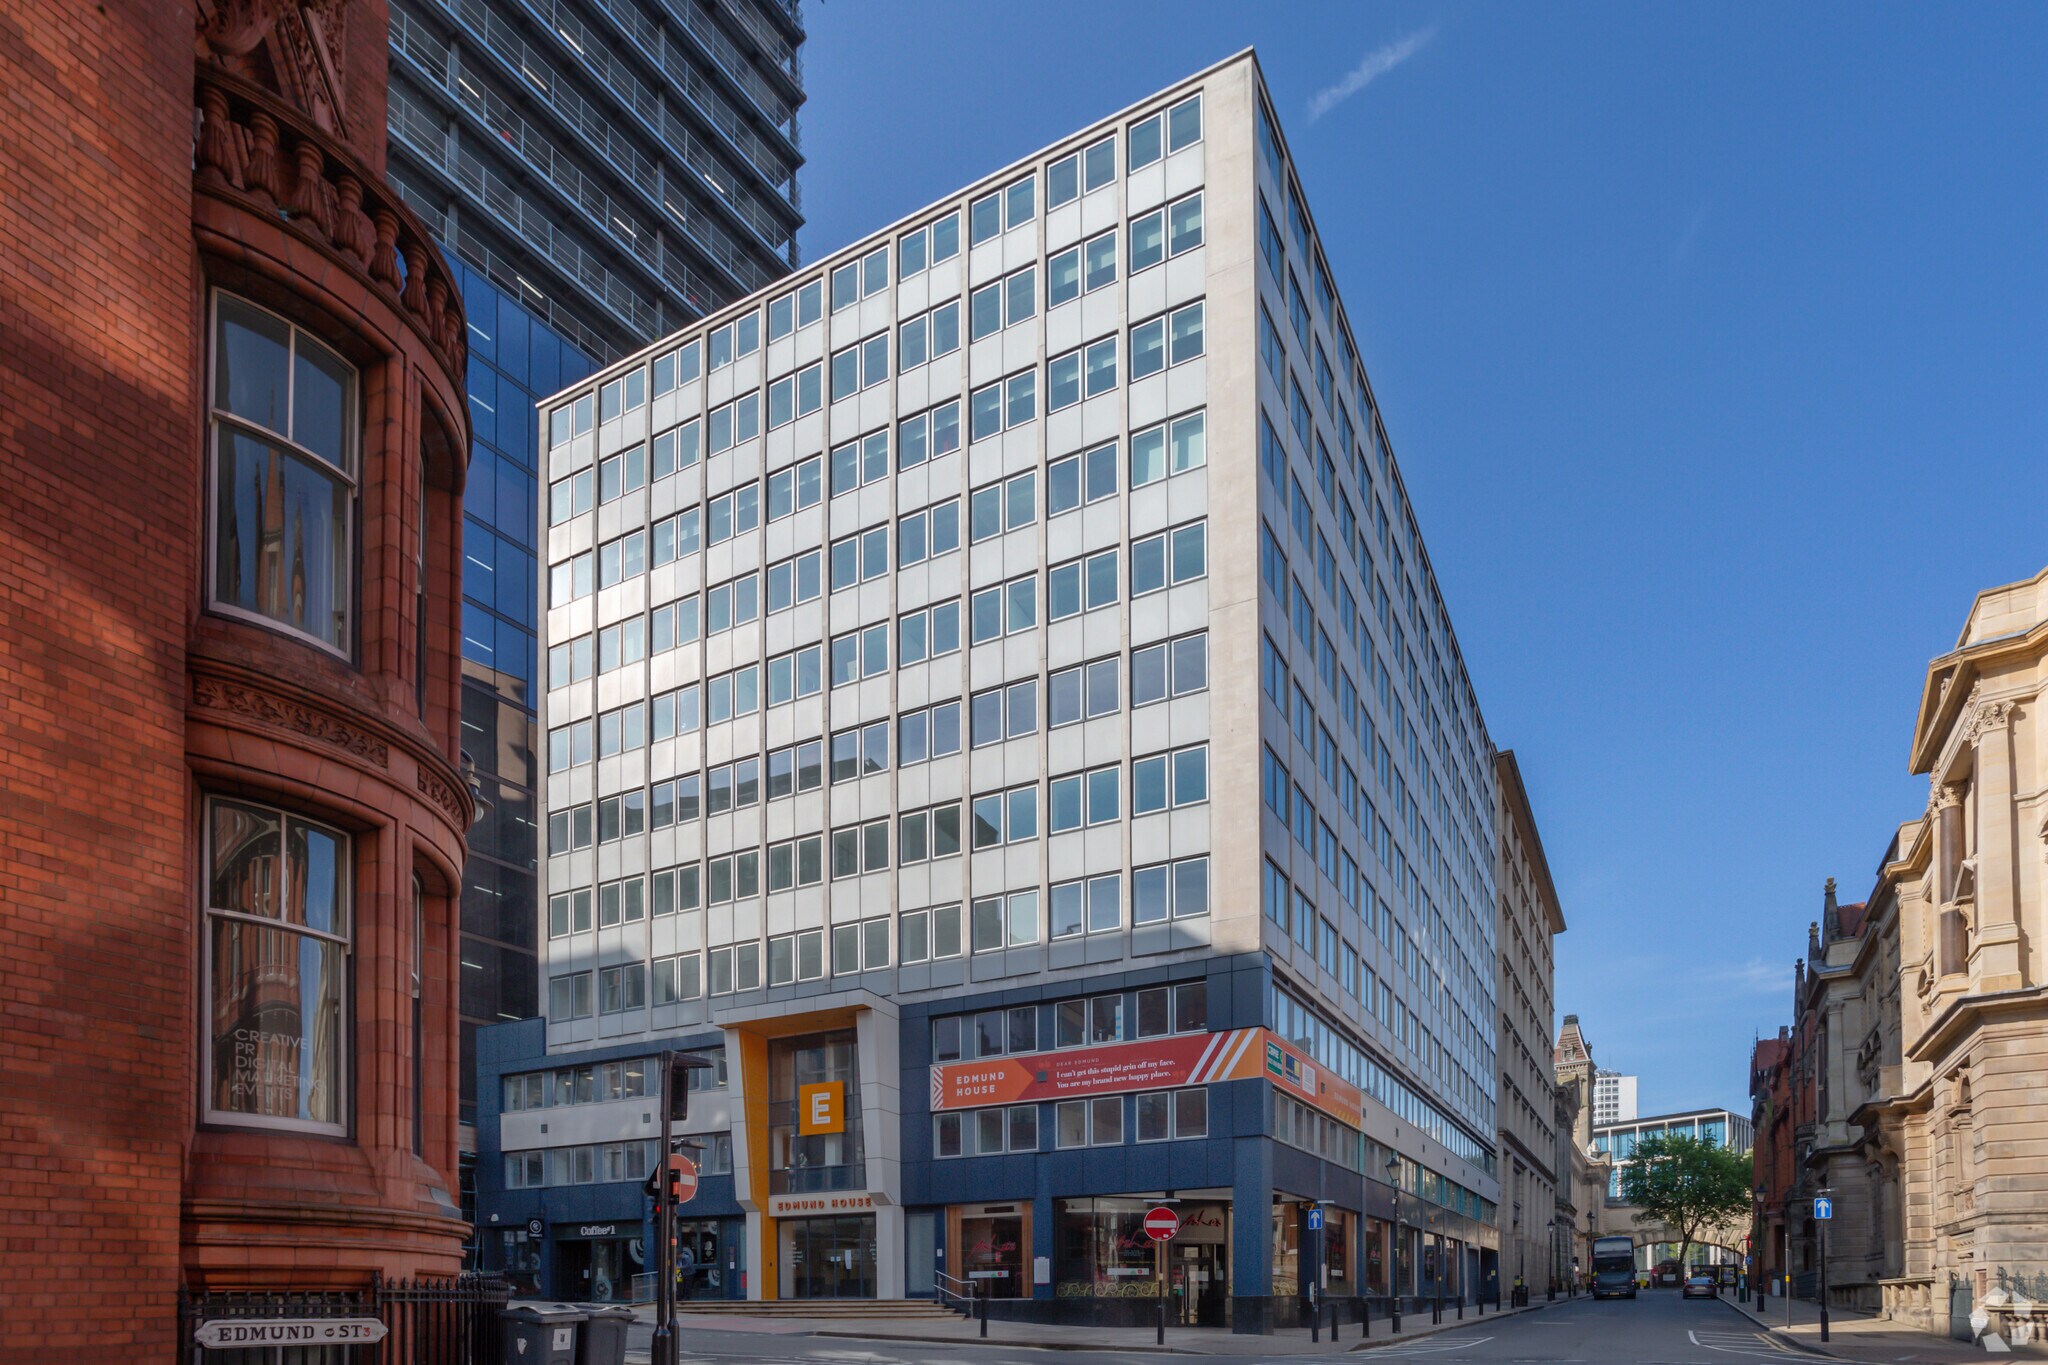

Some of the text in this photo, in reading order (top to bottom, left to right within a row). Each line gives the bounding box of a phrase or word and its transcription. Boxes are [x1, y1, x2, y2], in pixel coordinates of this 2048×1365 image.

[235, 1028, 308, 1050] CREATIVE
[235, 1042, 255, 1055] PR
[1060, 1069, 1076, 1078] can't
[1076, 1069, 1087, 1079] get
[1087, 1067, 1100, 1075] this
[1100, 1064, 1122, 1074] stupid
[1122, 1063, 1137, 1073] grin
[1137, 1061, 1147, 1069] off
[1147, 1061, 1158, 1069] my
[1159, 1059, 1176, 1067] face.
[235, 1069, 321, 1089] MAKETING
[956, 1071, 1005, 1085] EDMUND
[1056, 1081, 1069, 1089] You
[1092, 1076, 1112, 1085] brand
[1128, 1073, 1150, 1082] happy
[1150, 1070, 1171, 1080] place.
[235, 1083, 292, 1100] EVETS
[956, 1085, 995, 1096] HOUSE
[812, 1091, 831, 1125] E
[777, 1197, 873, 1211] EDMUND HOUSE
[218, 1325, 315, 1342] EDMUND
[339, 1325, 363, 1338] ST
[363, 1327, 371, 1337] 3
